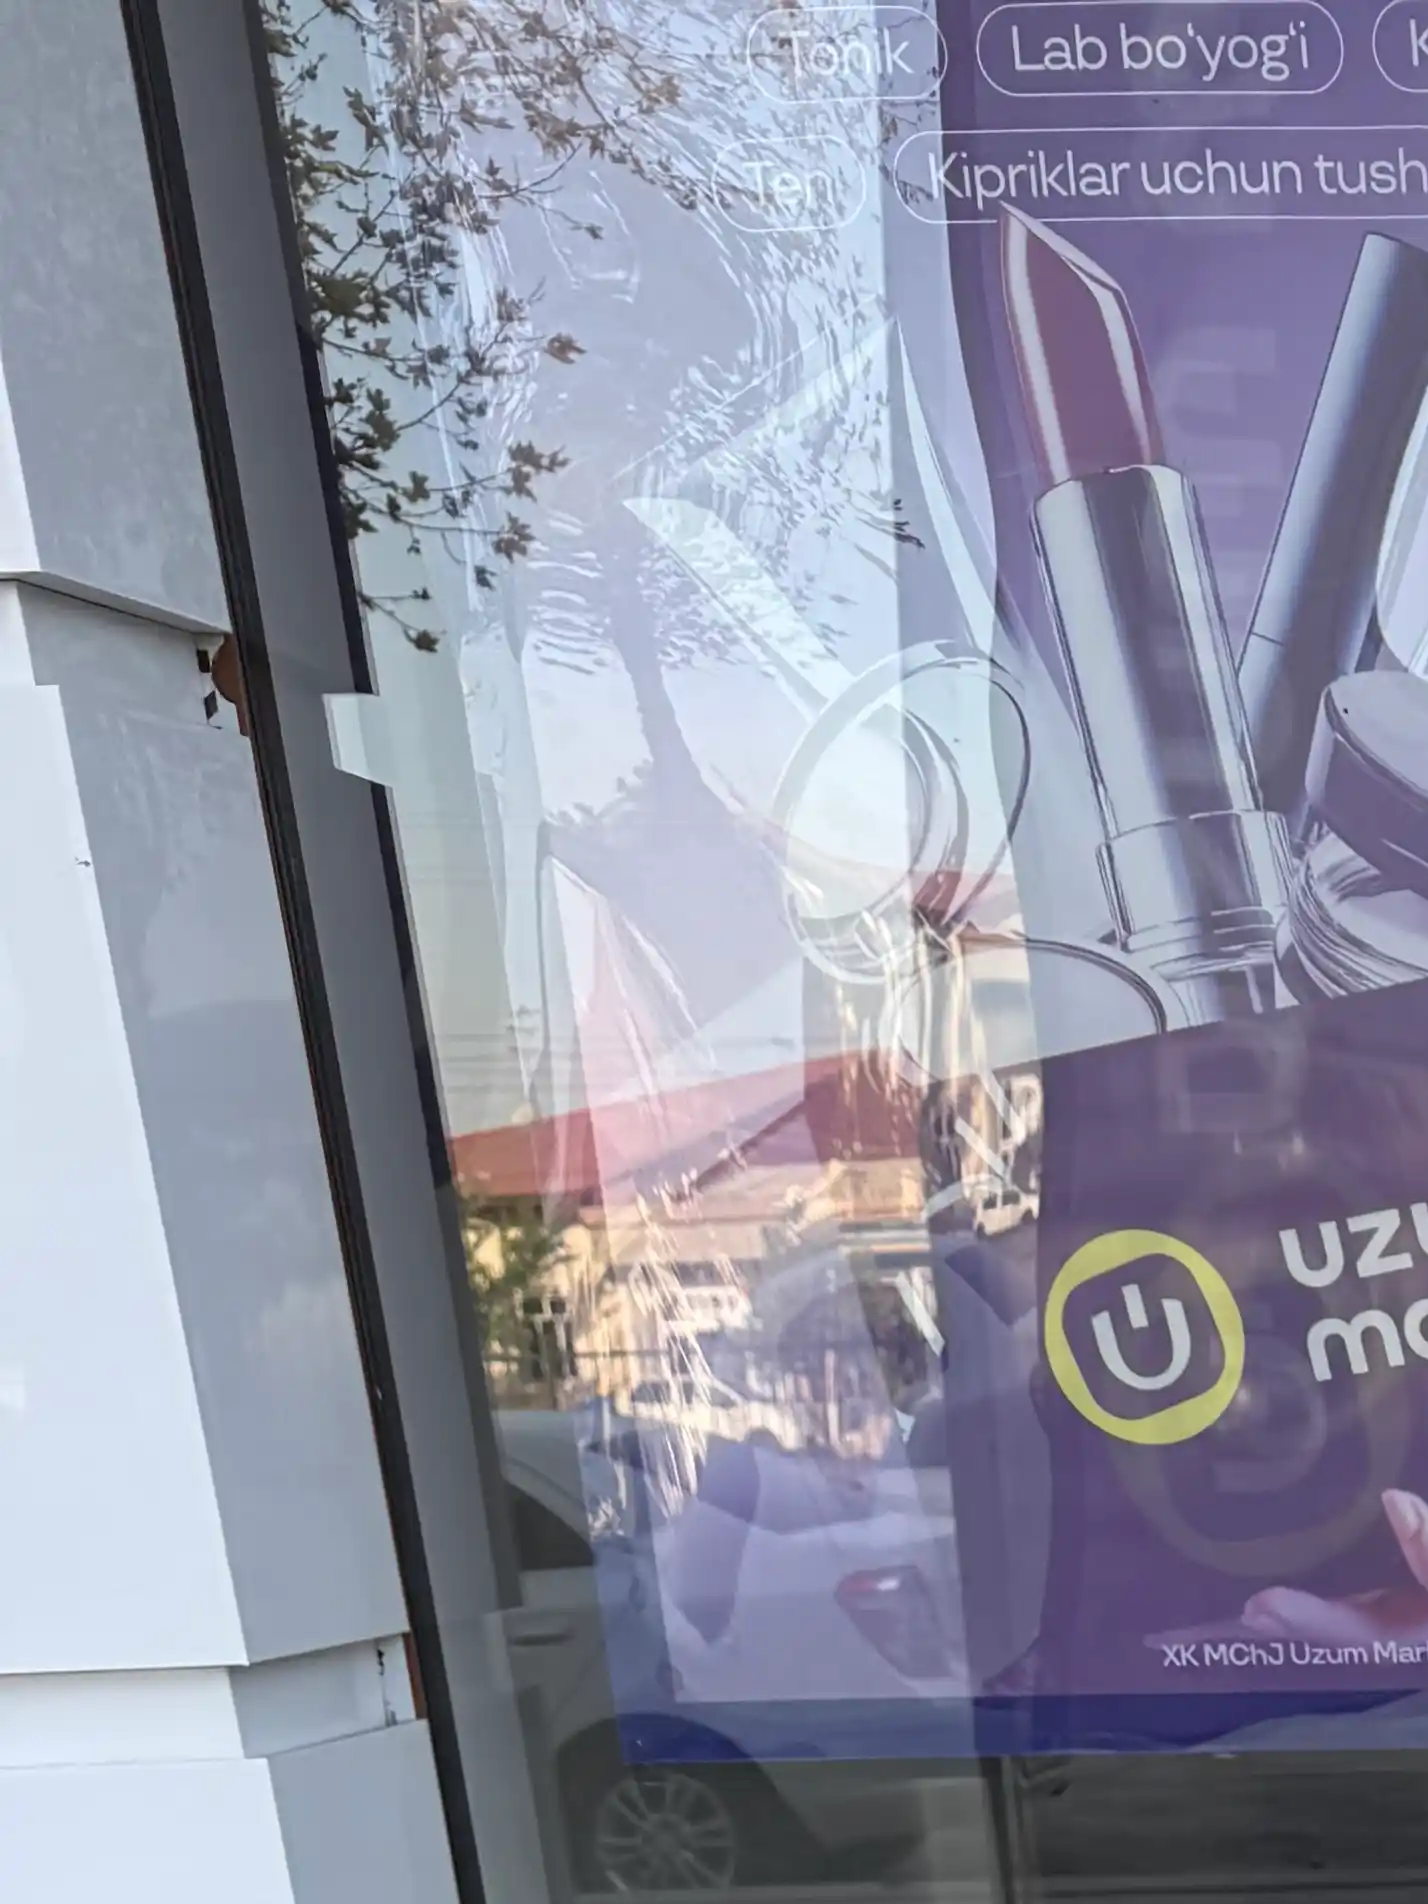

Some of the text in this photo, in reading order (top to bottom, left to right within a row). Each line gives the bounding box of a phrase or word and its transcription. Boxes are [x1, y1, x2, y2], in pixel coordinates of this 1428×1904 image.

[779, 27, 915, 77] Tonik
[1012, 24, 1107, 71] Lab
[928, 150, 1127, 210] Kipriklar
[1141, 150, 1302, 195] uchun
[1163, 1643, 1200, 1667] XK
[1204, 1641, 1285, 1667] MChJ
[1290, 1641, 1368, 1665] Uzum
